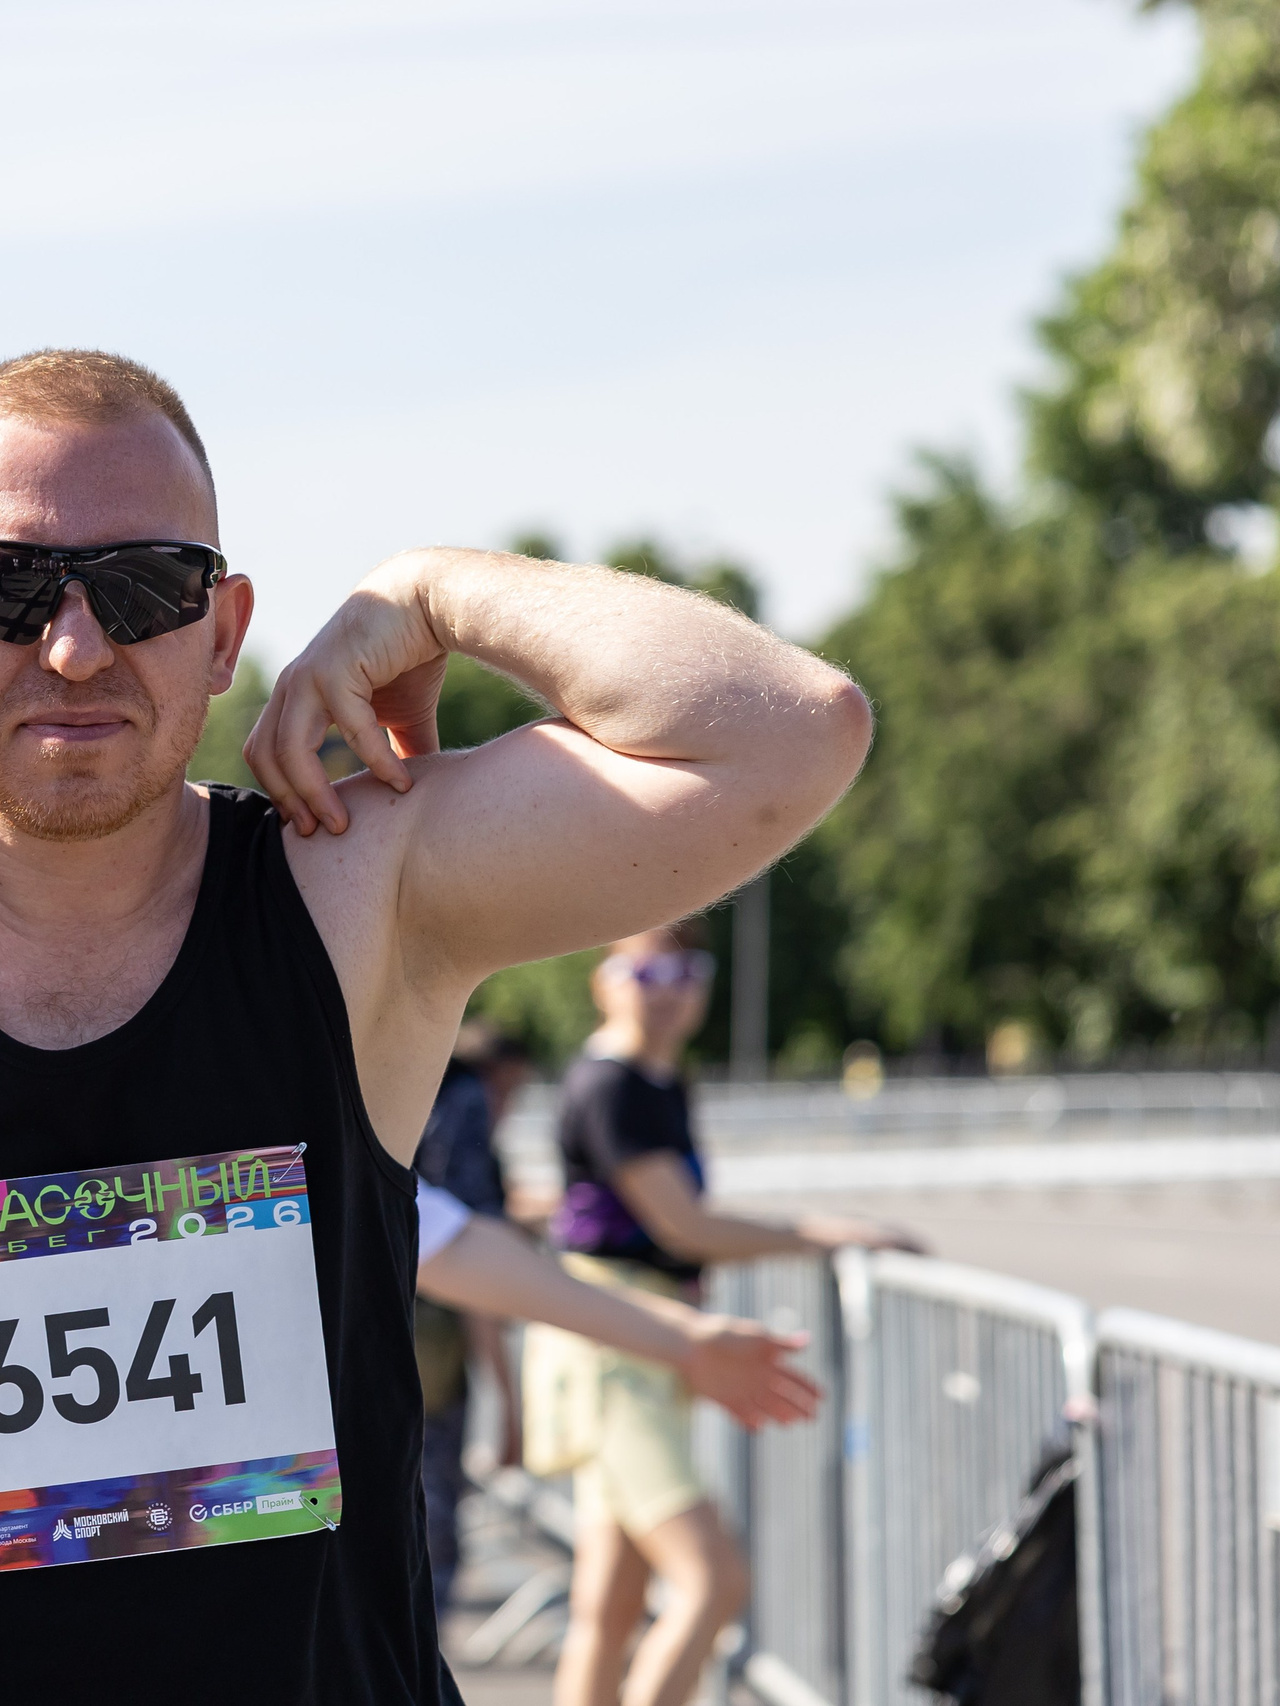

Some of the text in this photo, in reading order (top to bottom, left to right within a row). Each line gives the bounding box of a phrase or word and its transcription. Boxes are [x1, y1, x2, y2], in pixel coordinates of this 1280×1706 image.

[128, 1200, 302, 1246] 2026
[211, 1497, 294, 1517] СБЕР Прайм
[73, 1508, 129, 1528] МОСКОВСКИЙ
[74, 1526, 101, 1539] СПОРТ
